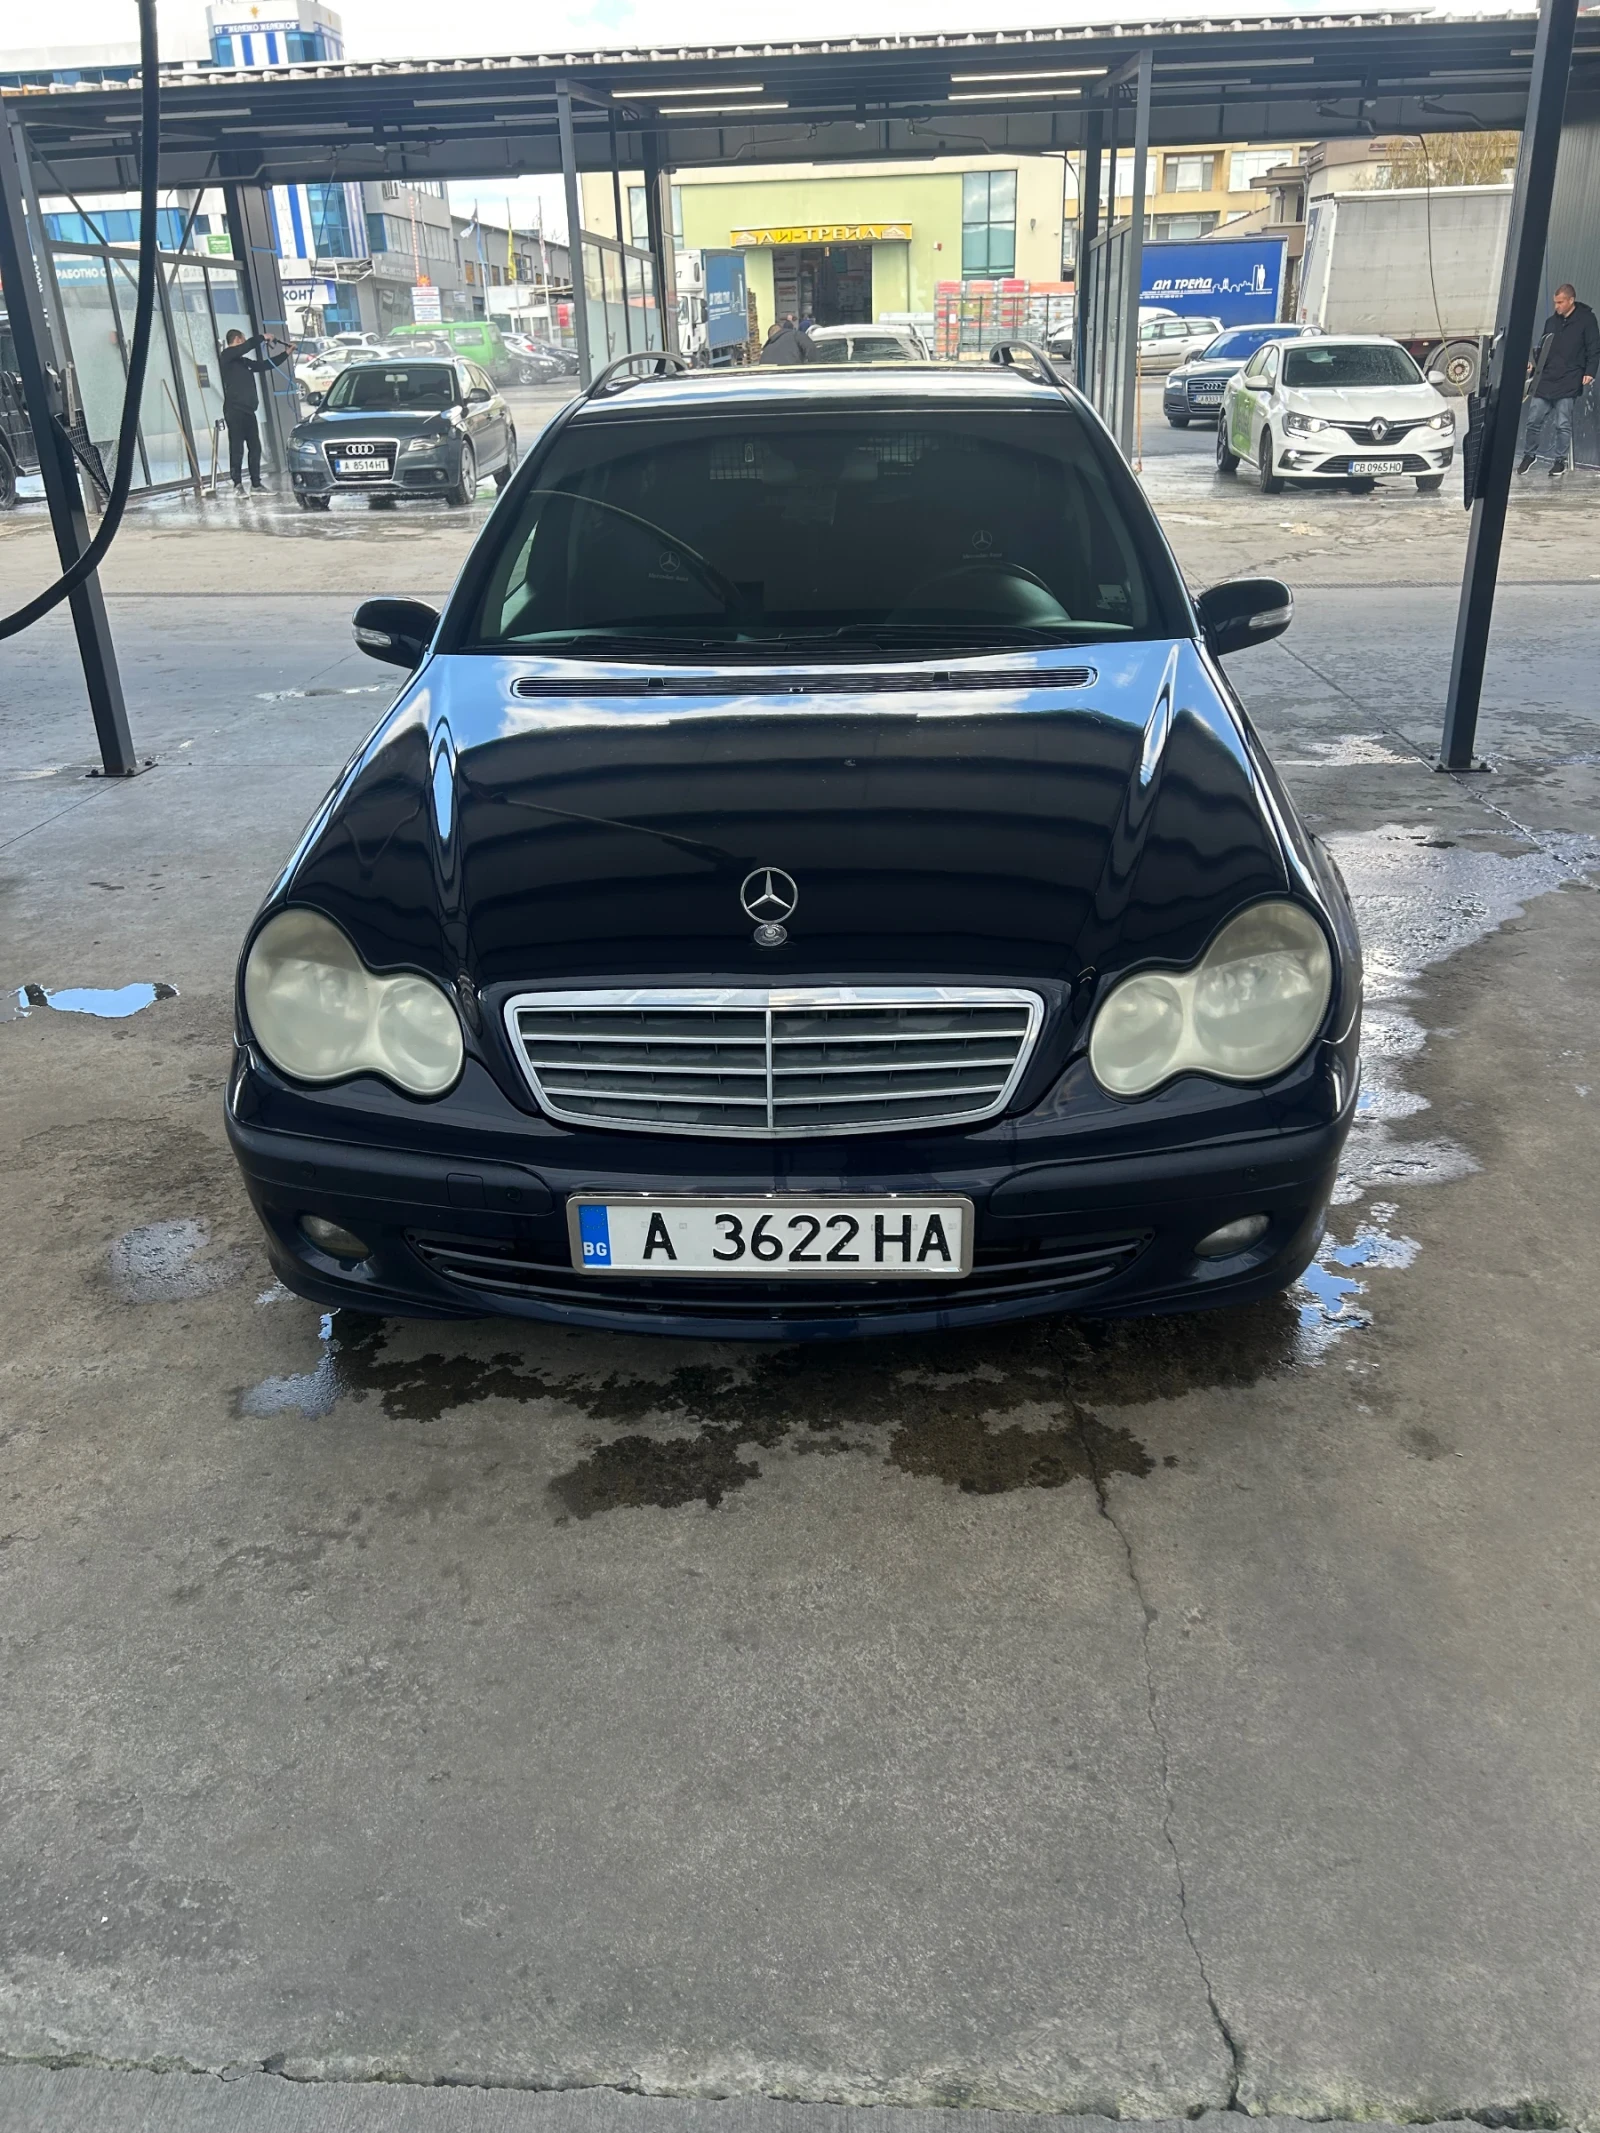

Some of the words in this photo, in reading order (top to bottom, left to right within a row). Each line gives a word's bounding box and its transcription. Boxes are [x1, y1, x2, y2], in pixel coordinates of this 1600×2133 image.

[761, 226, 879, 245] ДИ-ТРЕЙД
[1152, 280, 1172, 290] ДИ
[1174, 277, 1212, 290] ТРЕЙД
[583, 1241, 607, 1257] BG
[642, 1212, 677, 1260] A
